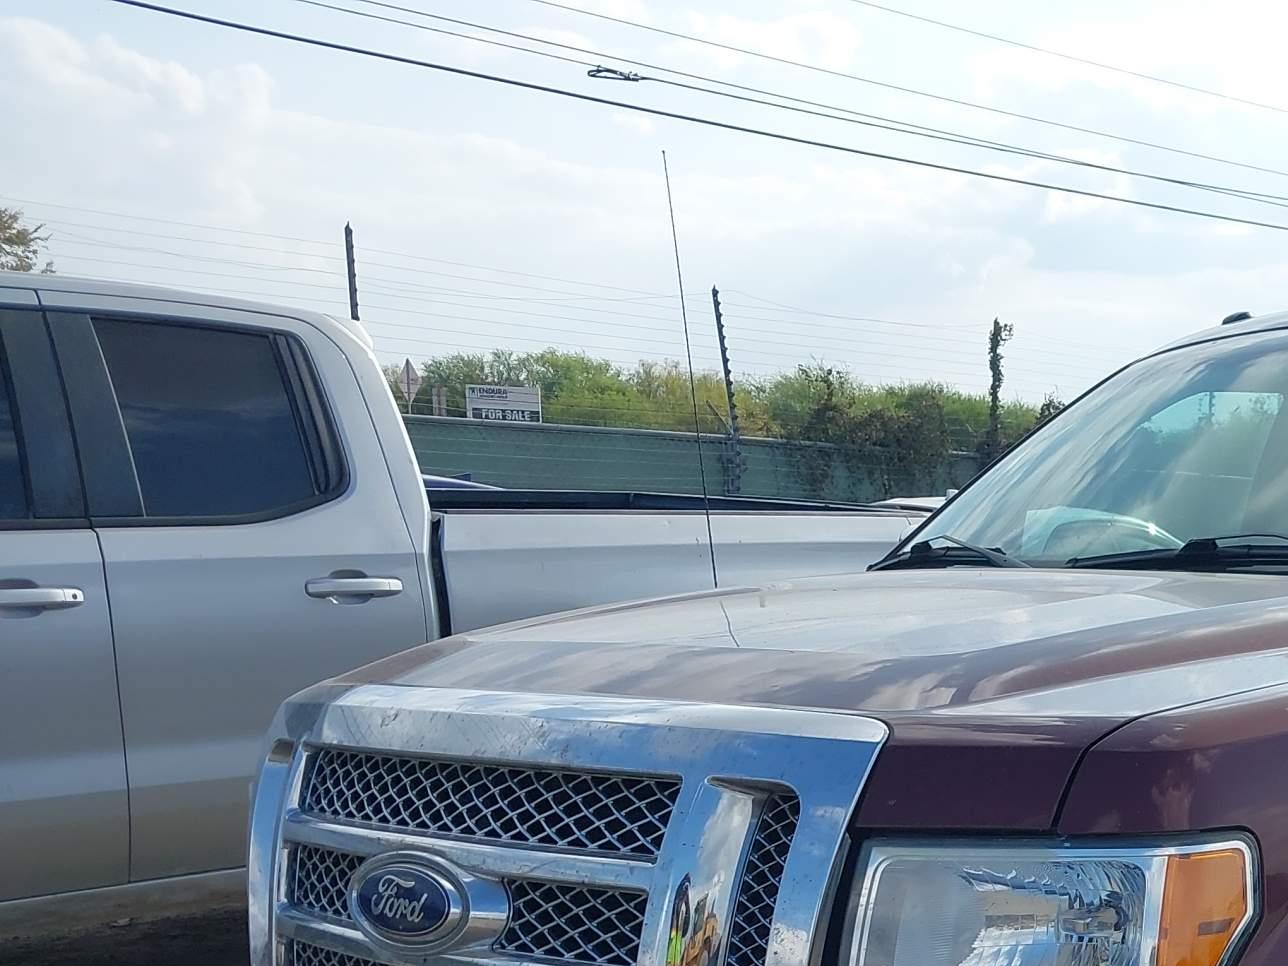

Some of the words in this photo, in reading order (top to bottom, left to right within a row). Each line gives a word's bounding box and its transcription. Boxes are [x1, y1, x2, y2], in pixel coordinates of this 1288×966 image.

[481, 408, 503, 420] FOR
[505, 410, 531, 421] SALE
[371, 874, 428, 923] Ford
